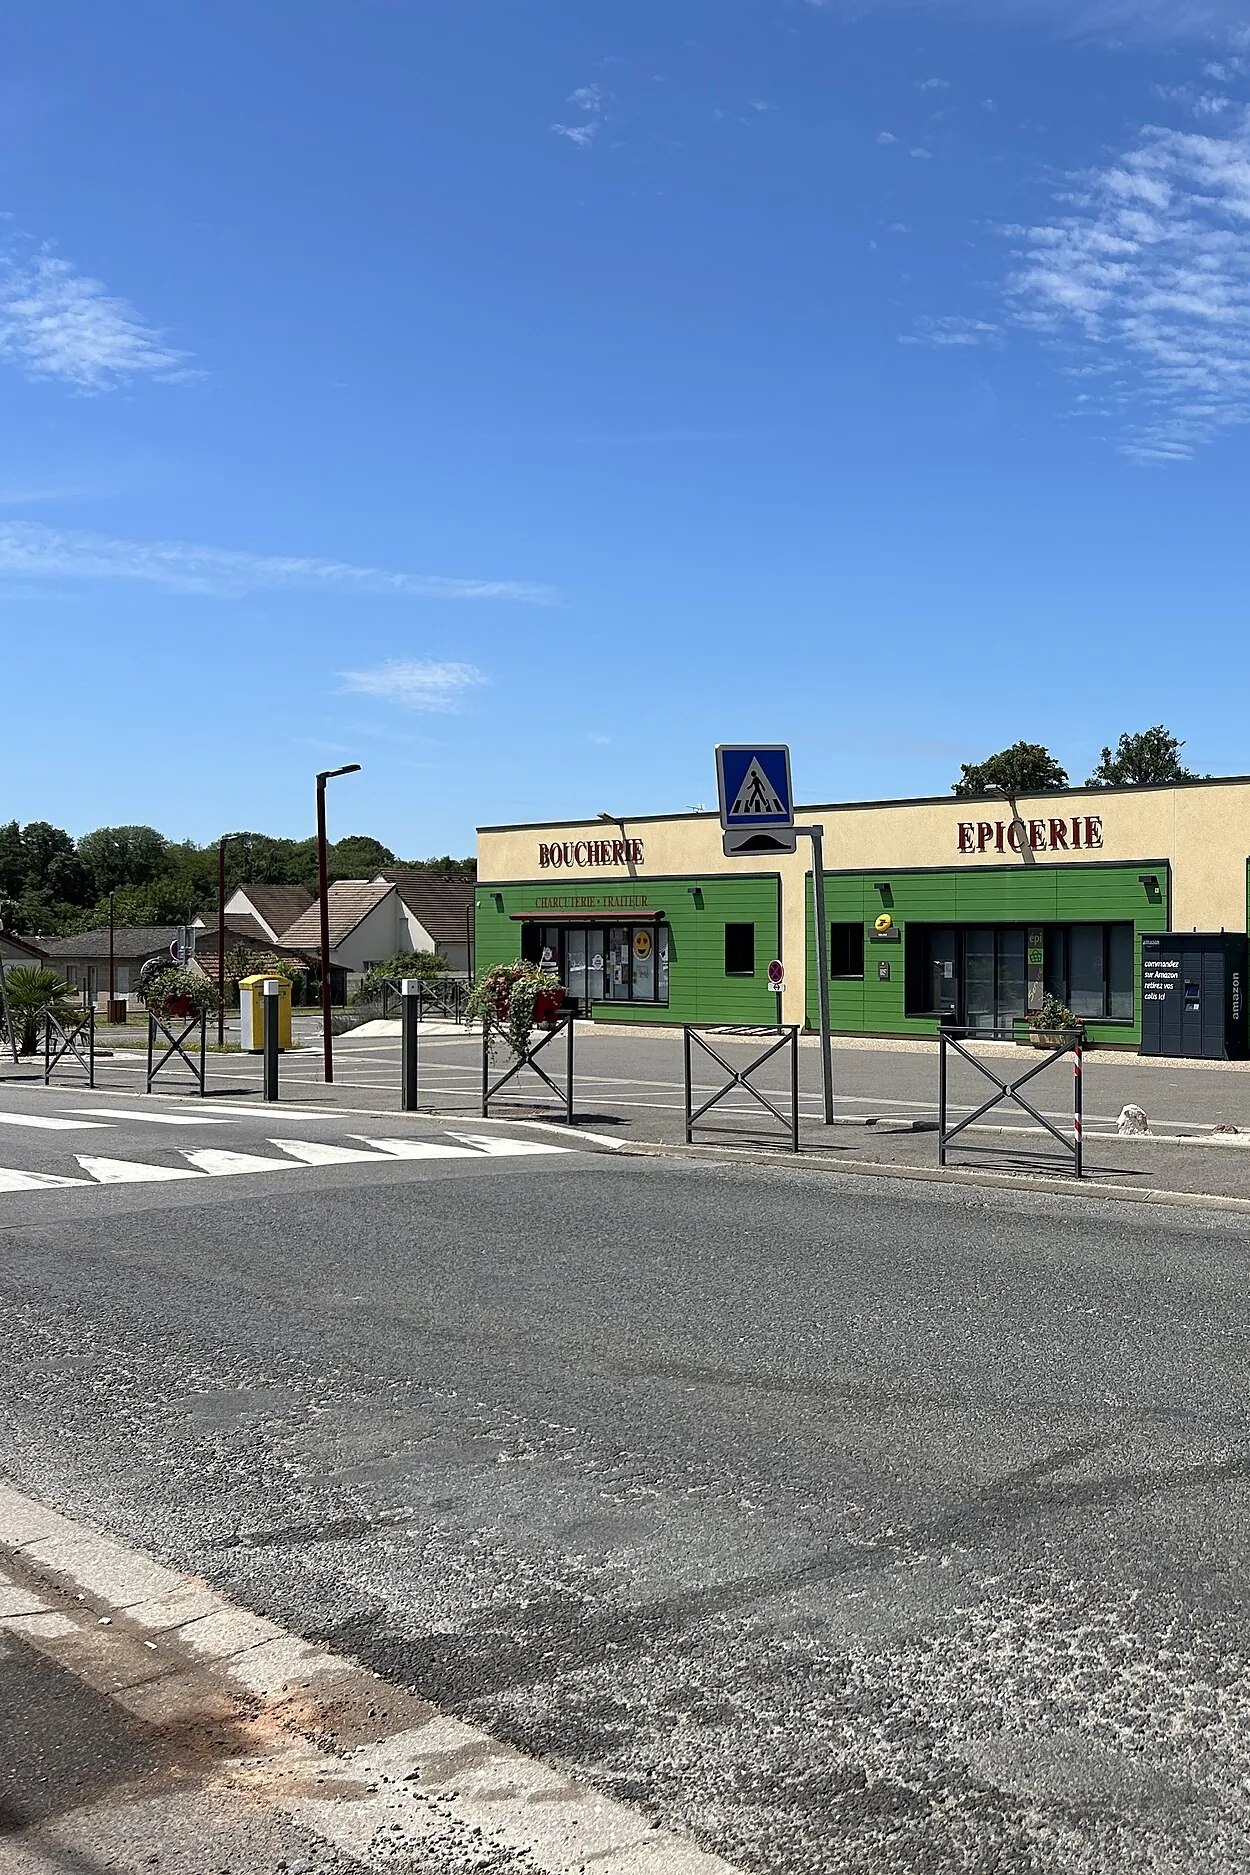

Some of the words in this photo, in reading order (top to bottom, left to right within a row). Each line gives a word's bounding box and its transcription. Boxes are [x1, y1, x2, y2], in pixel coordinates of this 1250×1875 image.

[957, 816, 1103, 852] EPICERIE
[538, 838, 644, 868] BOUCHERIE
[535, 896, 596, 909] CHARCUTERIE
[603, 895, 648, 907] TRAITEUR
[1144, 960, 1179, 968] commandez
[1154, 971, 1178, 979] Amazon
[1144, 982, 1163, 990] retirez
[1144, 993, 1158, 1001] colis
[1232, 972, 1240, 1020] amazon
